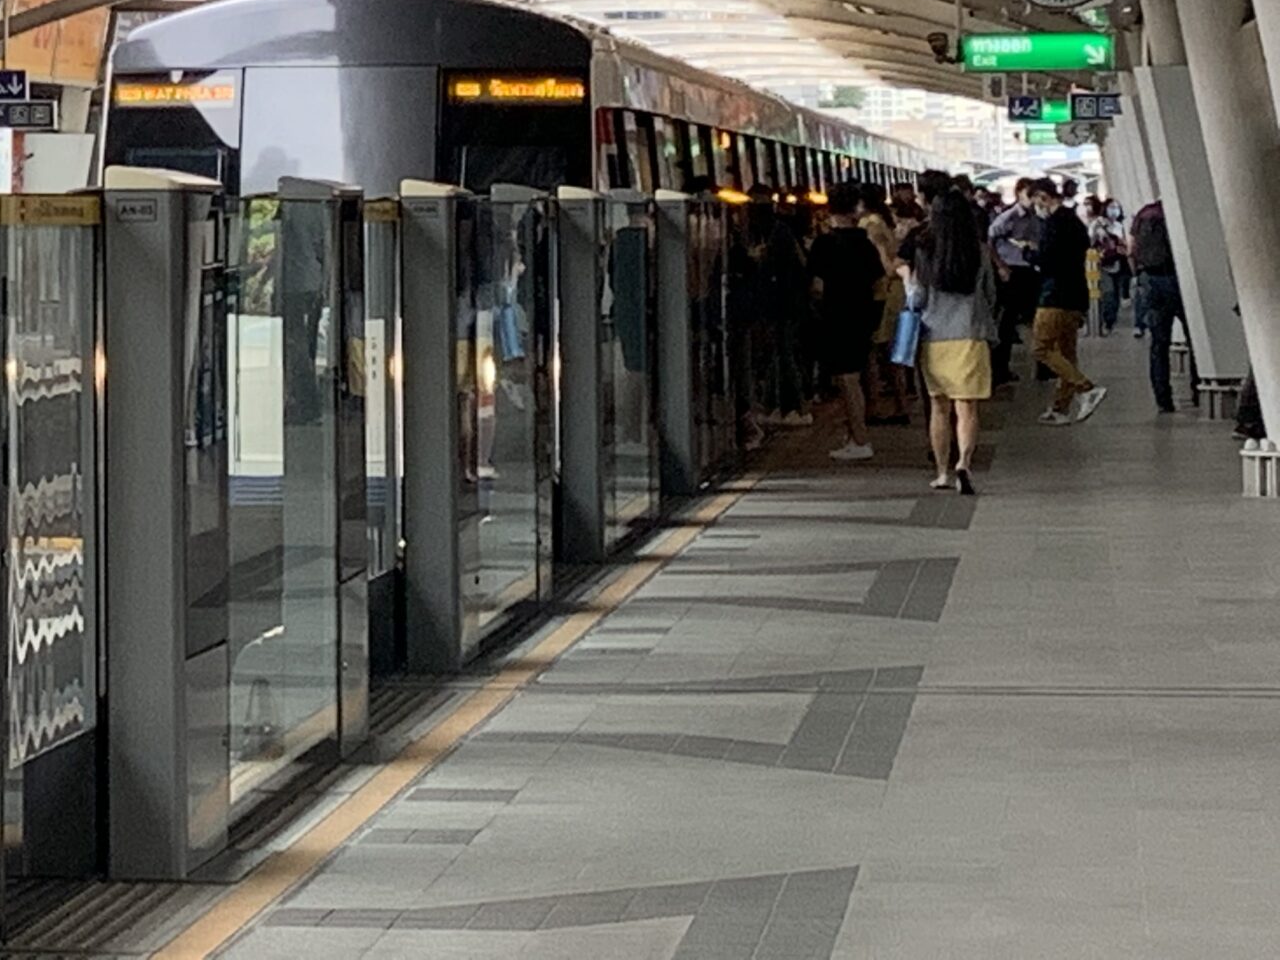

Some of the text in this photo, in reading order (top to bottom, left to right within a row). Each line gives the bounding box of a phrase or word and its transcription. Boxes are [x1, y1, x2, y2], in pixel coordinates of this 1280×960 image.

[972, 36, 1032, 53] ทางออก
[972, 54, 997, 66] Exit
